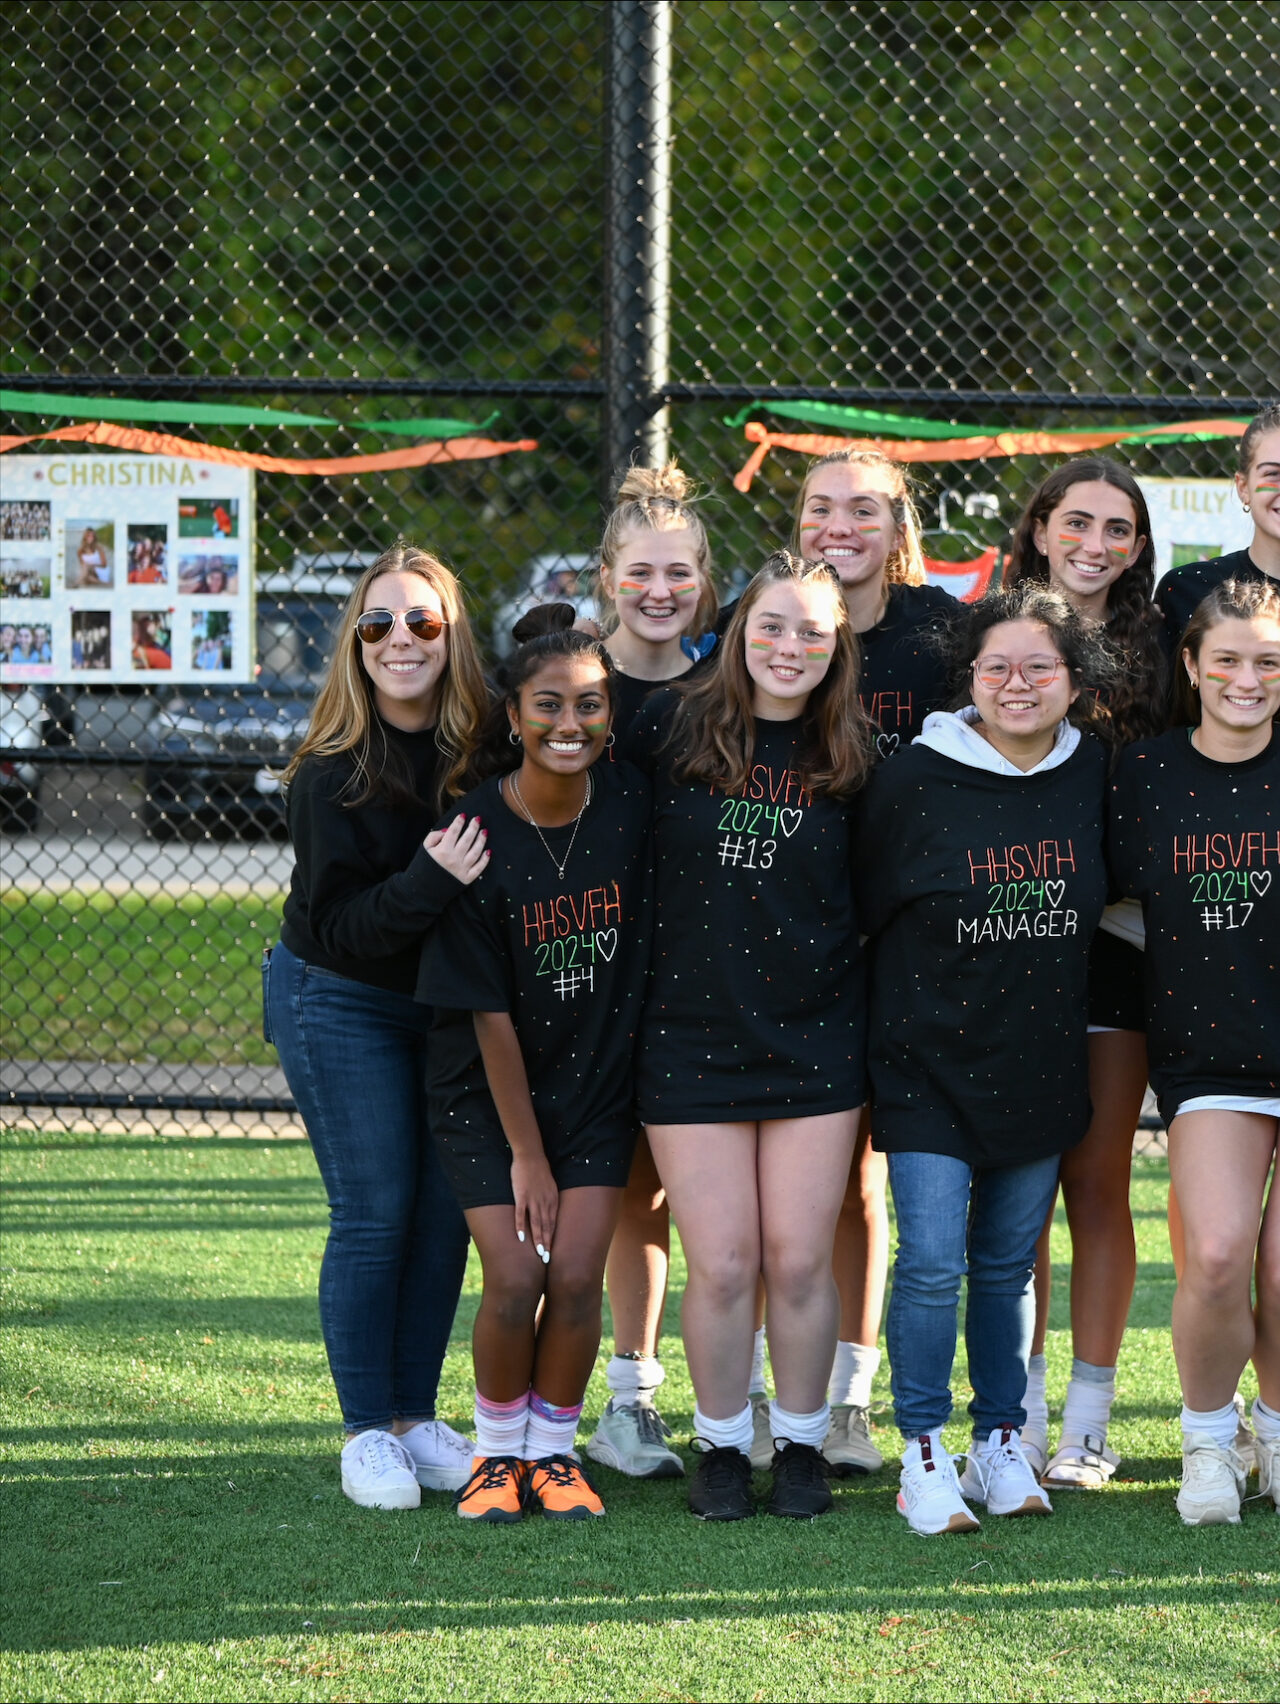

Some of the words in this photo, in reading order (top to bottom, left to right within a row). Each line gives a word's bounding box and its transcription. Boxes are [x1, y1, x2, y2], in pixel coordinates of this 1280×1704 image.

[47, 462, 195, 486] CHRISTINA
[1170, 487, 1228, 514] LILLY
[717, 799, 780, 837] 2024
[717, 835, 777, 869] #13
[967, 838, 1076, 885] HHSVFH
[987, 880, 1045, 914] 2024
[1188, 870, 1248, 903] 2024
[522, 884, 622, 947] HHSVFH
[957, 909, 1079, 943] MANAGER
[1200, 902, 1255, 931] #17
[534, 932, 596, 976] 2024
[552, 965, 594, 1001] #4
